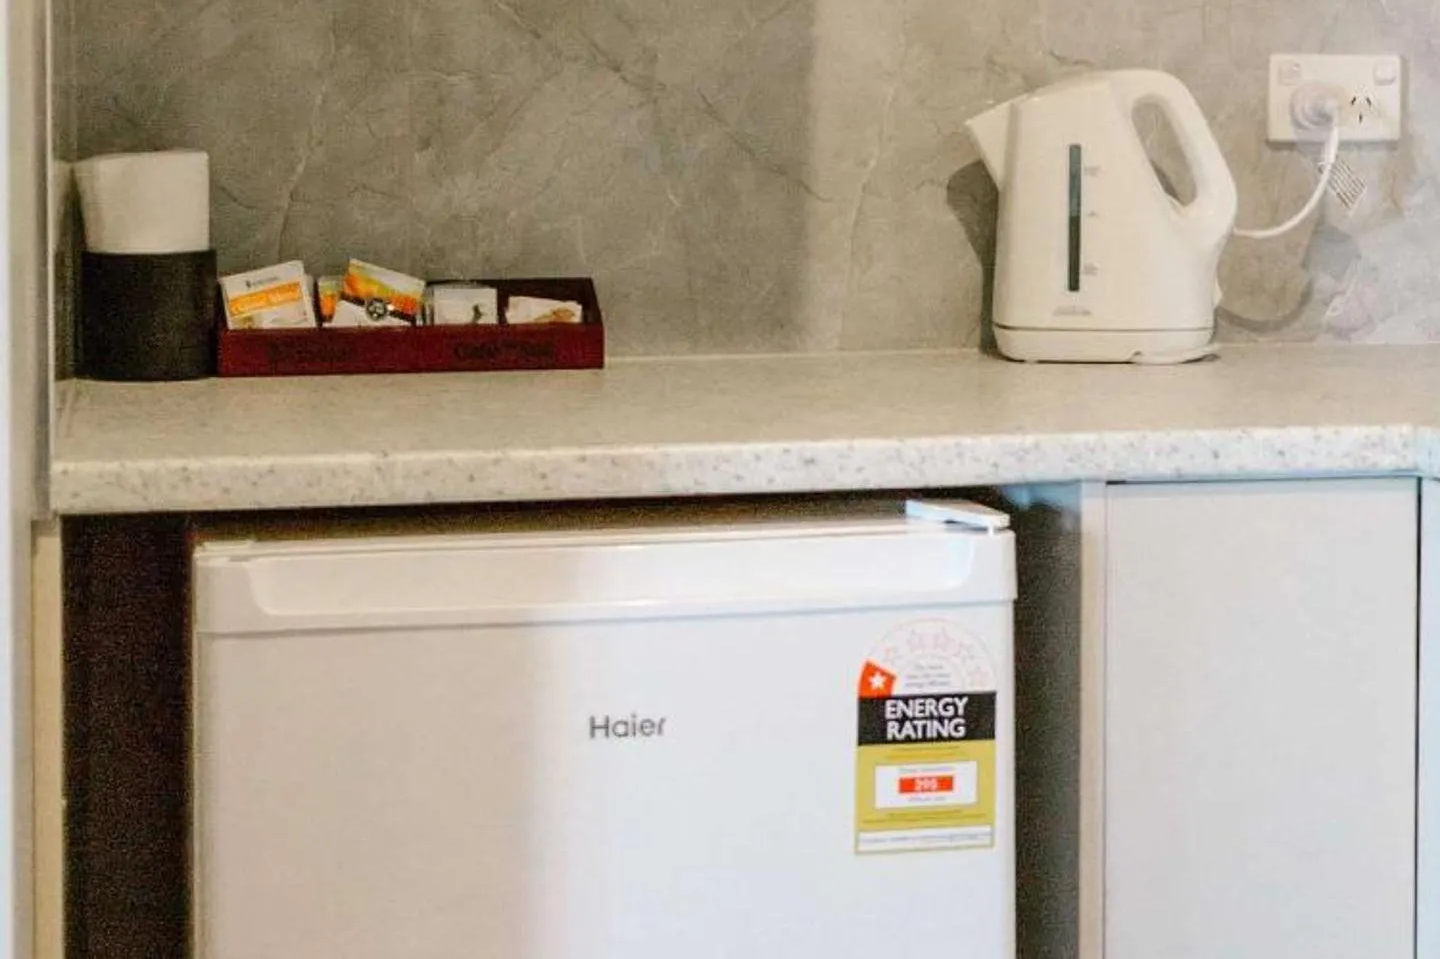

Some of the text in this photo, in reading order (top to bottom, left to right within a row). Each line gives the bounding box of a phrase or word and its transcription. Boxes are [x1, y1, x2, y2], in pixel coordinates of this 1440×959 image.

[885, 696, 969, 720] ENERGY
[589, 712, 667, 739] Haier
[886, 717, 967, 741] RATING
